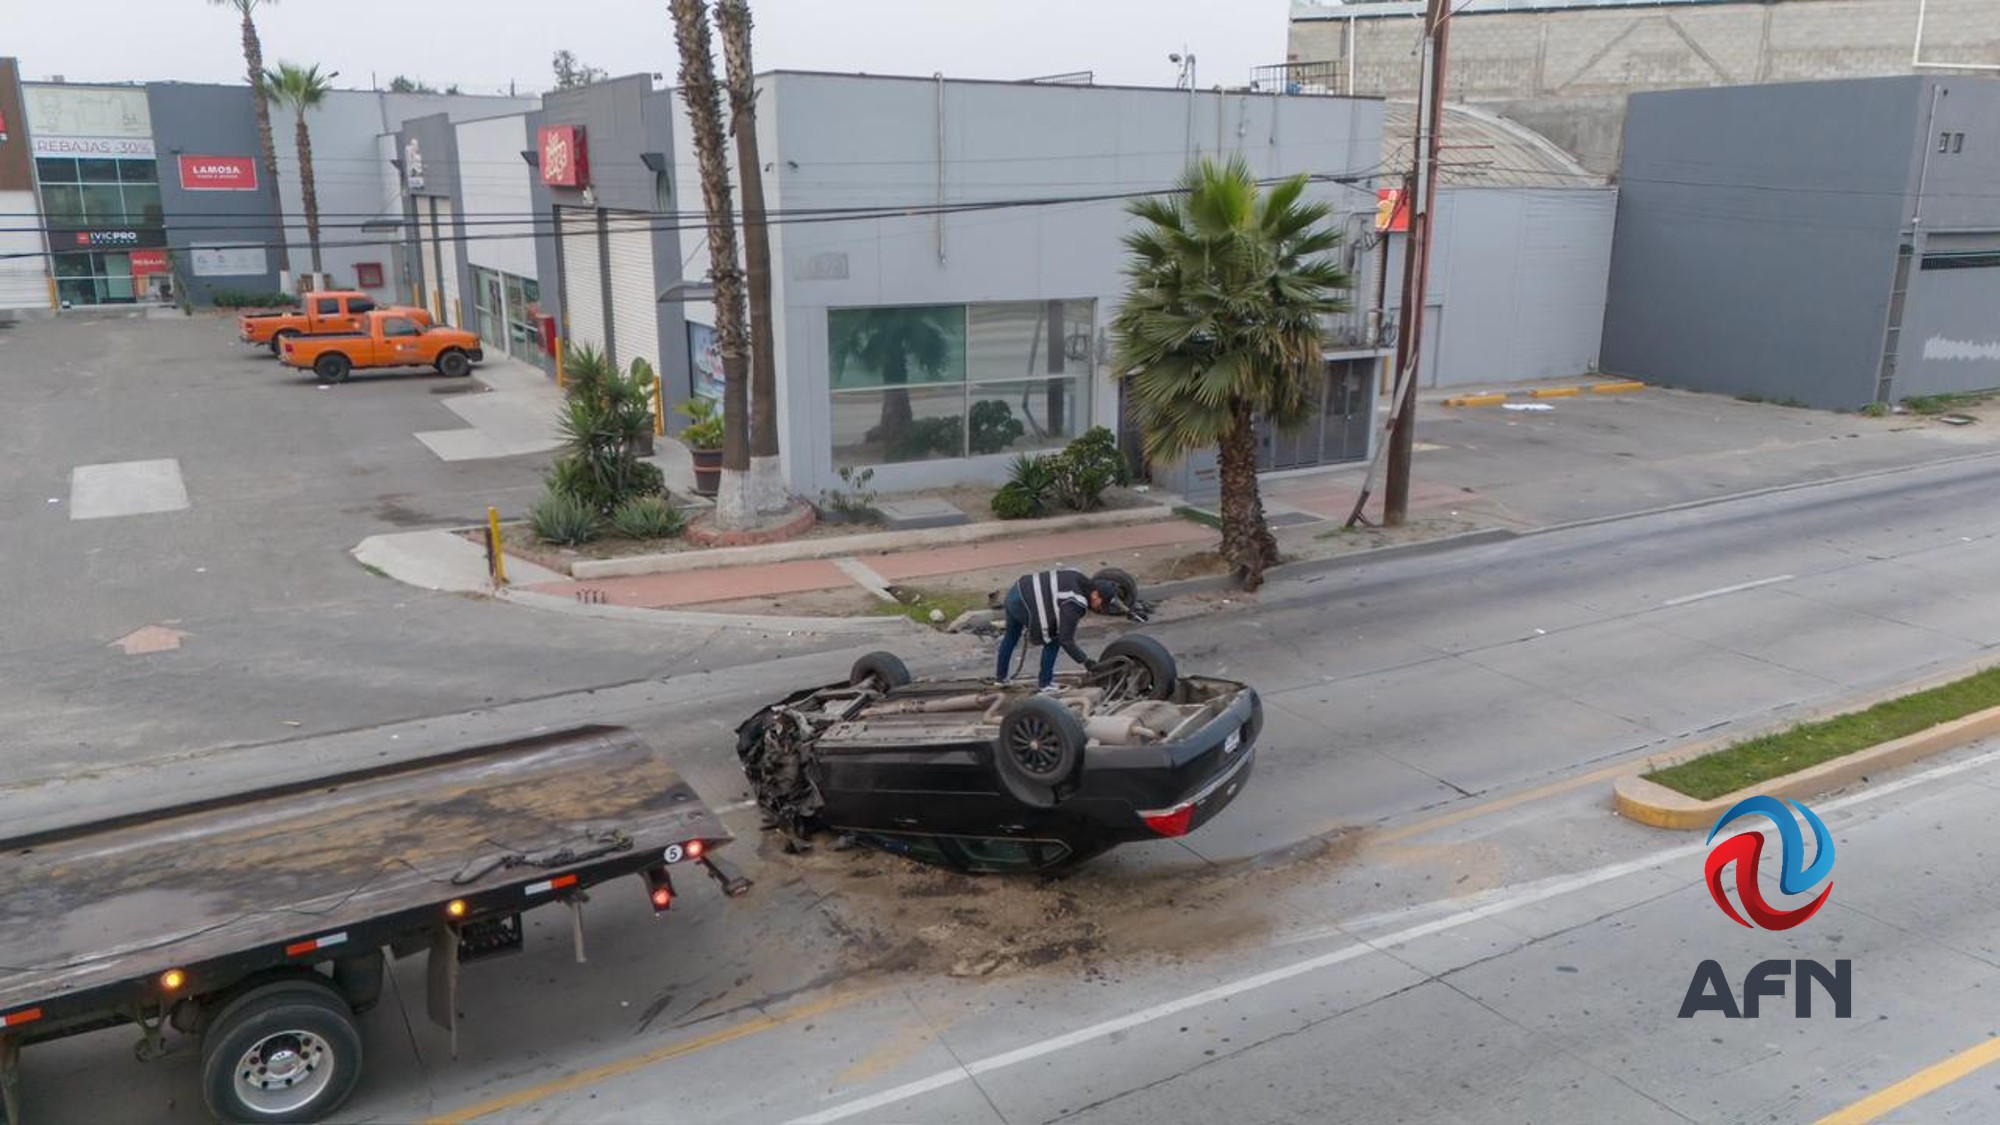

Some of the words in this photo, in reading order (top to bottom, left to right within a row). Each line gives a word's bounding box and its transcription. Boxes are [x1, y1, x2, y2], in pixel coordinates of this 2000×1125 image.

[37, 140, 113, 154] REBAJAS
[193, 165, 240, 174] LAMOSA
[669, 847, 678, 860] 5
